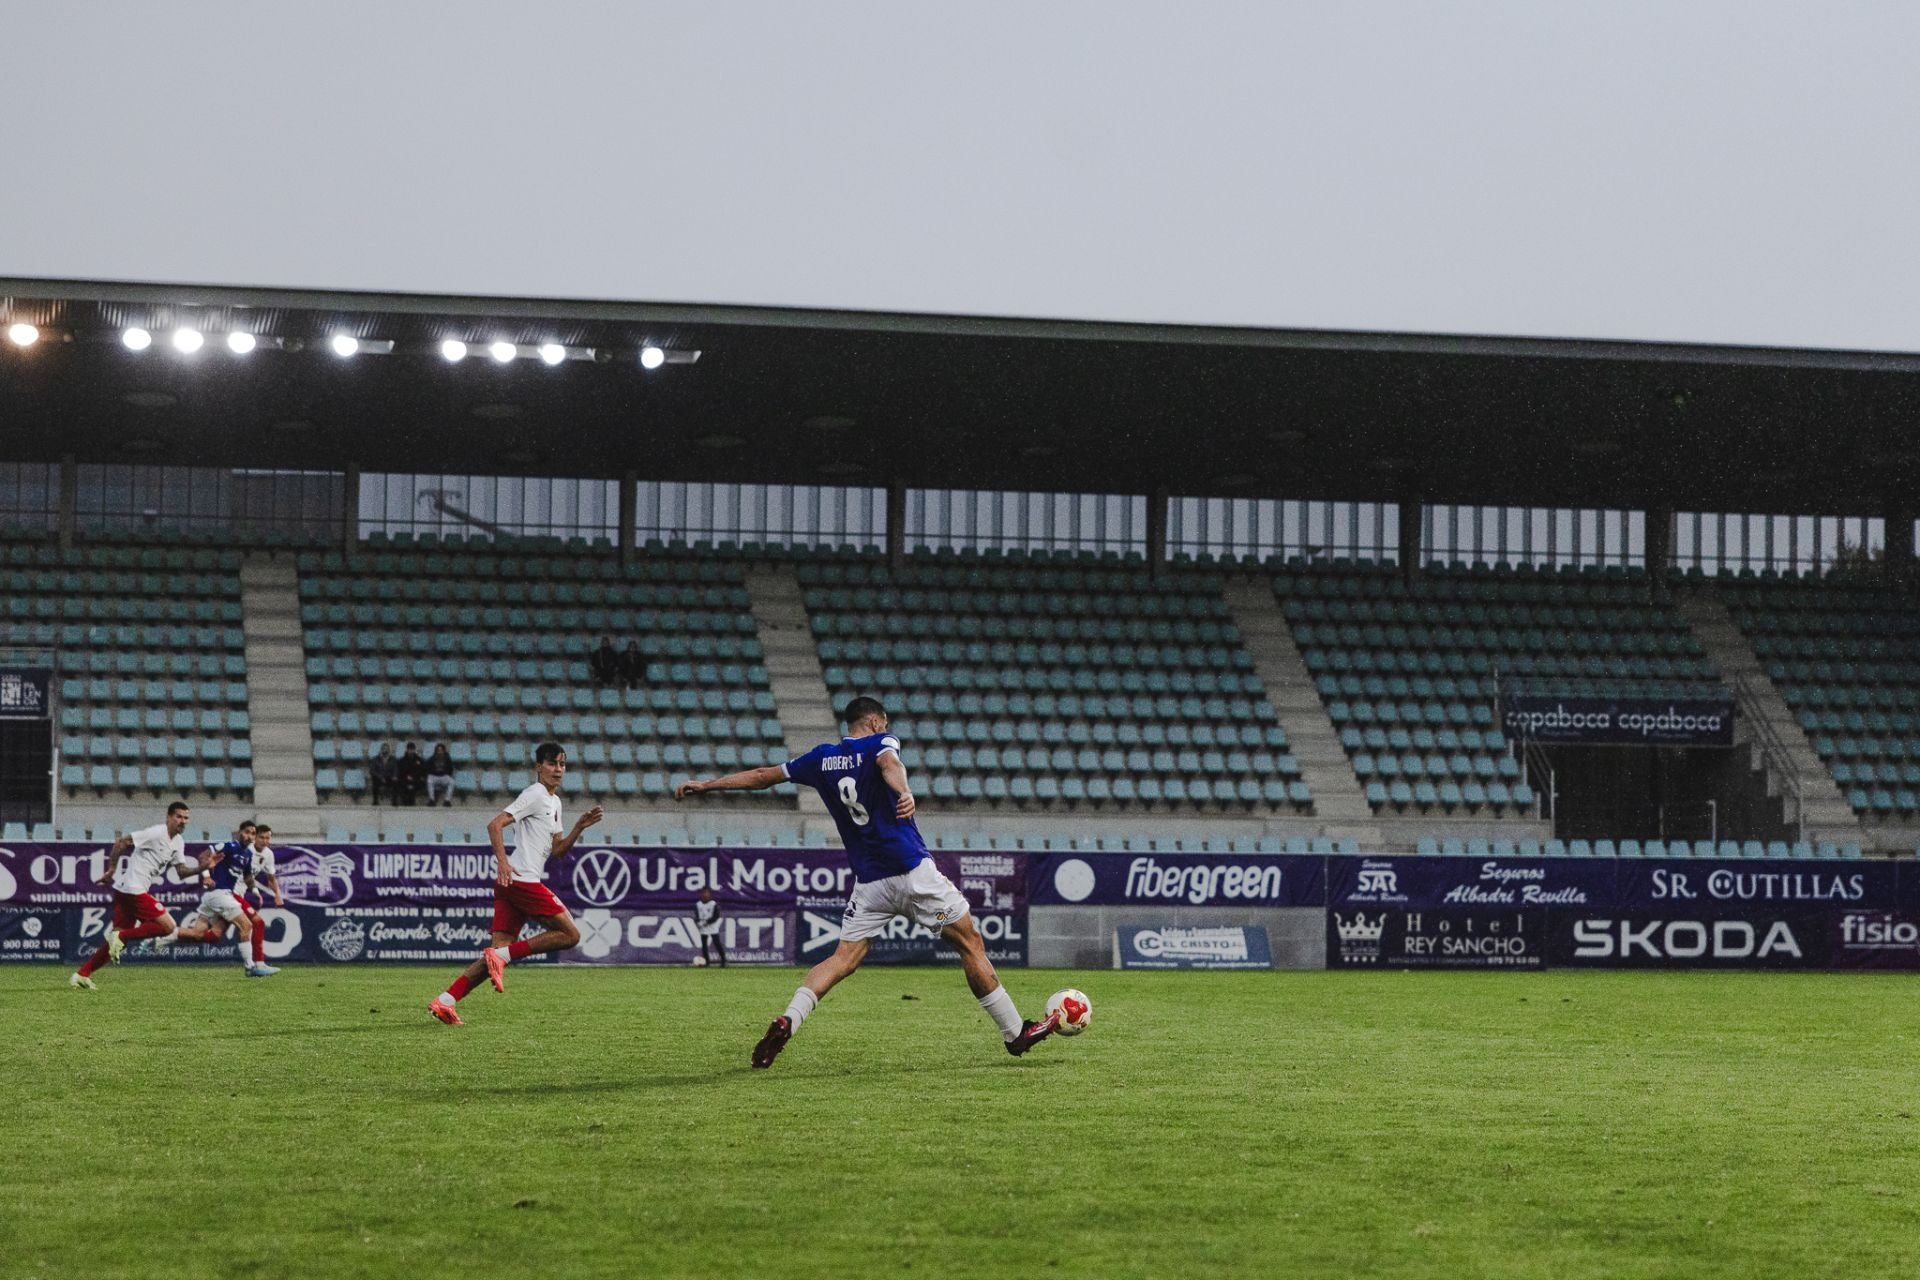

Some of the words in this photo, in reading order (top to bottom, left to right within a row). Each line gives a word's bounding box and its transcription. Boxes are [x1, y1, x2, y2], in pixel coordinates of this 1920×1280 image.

[1506, 703, 1610, 733] copaboca
[1619, 706, 1721, 736] copaboca
[838, 776, 869, 826] 8
[363, 854, 442, 879] LIMPIEZA
[638, 857, 721, 892] Ural
[732, 858, 851, 892] Motor
[1480, 862, 1546, 884] Seguros
[1125, 857, 1282, 904] fibergreen
[1358, 870, 1397, 892] SAR
[1651, 869, 1697, 898] SR.
[1707, 869, 1864, 900] CUTILLAS
[796, 895, 848, 907] Palencia
[1443, 884, 1515, 904] Albadri
[1521, 885, 1587, 904] Revilla
[369, 922, 431, 941] Gerardo
[628, 916, 785, 949] CAVITI
[1407, 913, 1523, 932] Hotel
[1839, 914, 1918, 943] fisio
[3, 940, 21, 949] 900
[23, 940, 40, 949] 802
[43, 940, 60, 949] 103
[203, 942, 235, 957] llevar
[1162, 940, 1176, 948] EL
[1181, 940, 1230, 949] CRISTO
[1404, 937, 1437, 955] REY
[1442, 937, 1526, 956] SANCHO
[1574, 920, 1803, 957] SKODA
